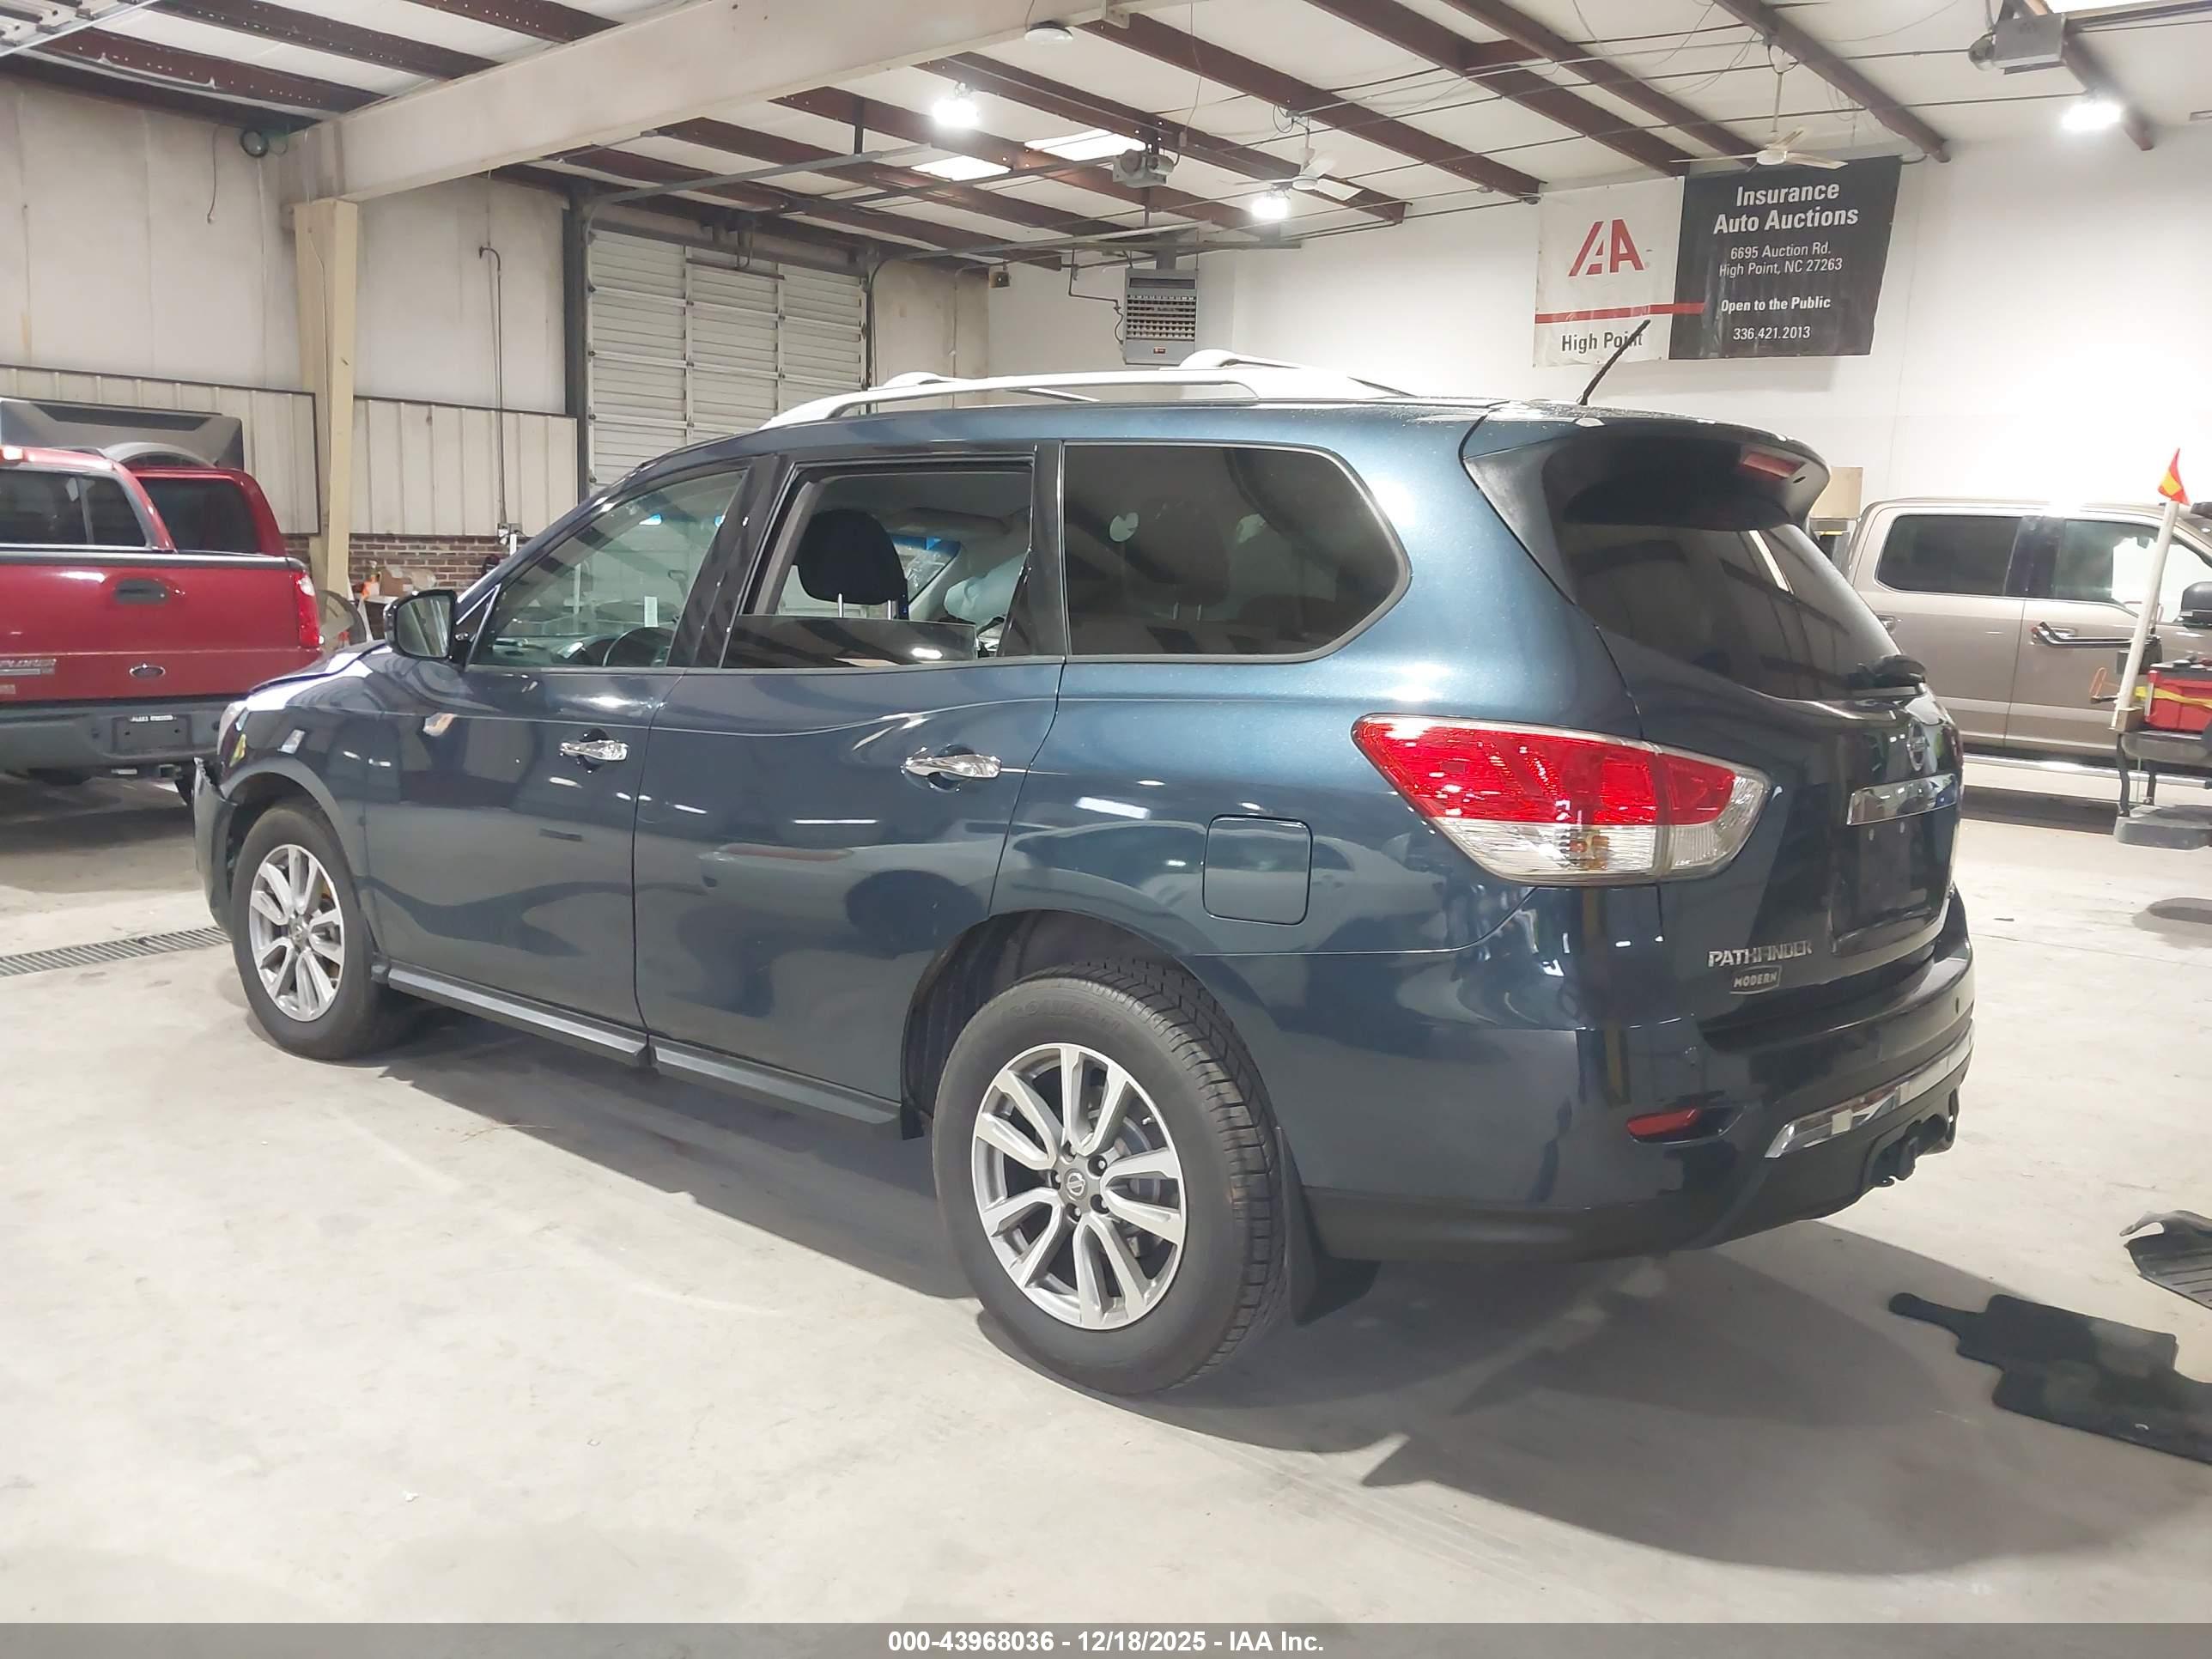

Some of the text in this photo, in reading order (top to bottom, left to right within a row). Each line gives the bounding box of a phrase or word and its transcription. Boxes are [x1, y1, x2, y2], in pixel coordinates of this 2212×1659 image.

[1736, 183, 1840, 207] Insurance
[1713, 206, 1860, 234] Auto Auctions
[1730, 241, 1832, 260] 6695 Auction Rd.
[1719, 257, 1843, 279] High Point, NC 27263
[1720, 295, 1832, 315] Open to the Public
[1561, 332, 1598, 355] High
[1732, 325, 1811, 340] 336.421.2013
[1707, 940, 1813, 968] PATHFINDER
[1733, 972, 1778, 988] MODERN
